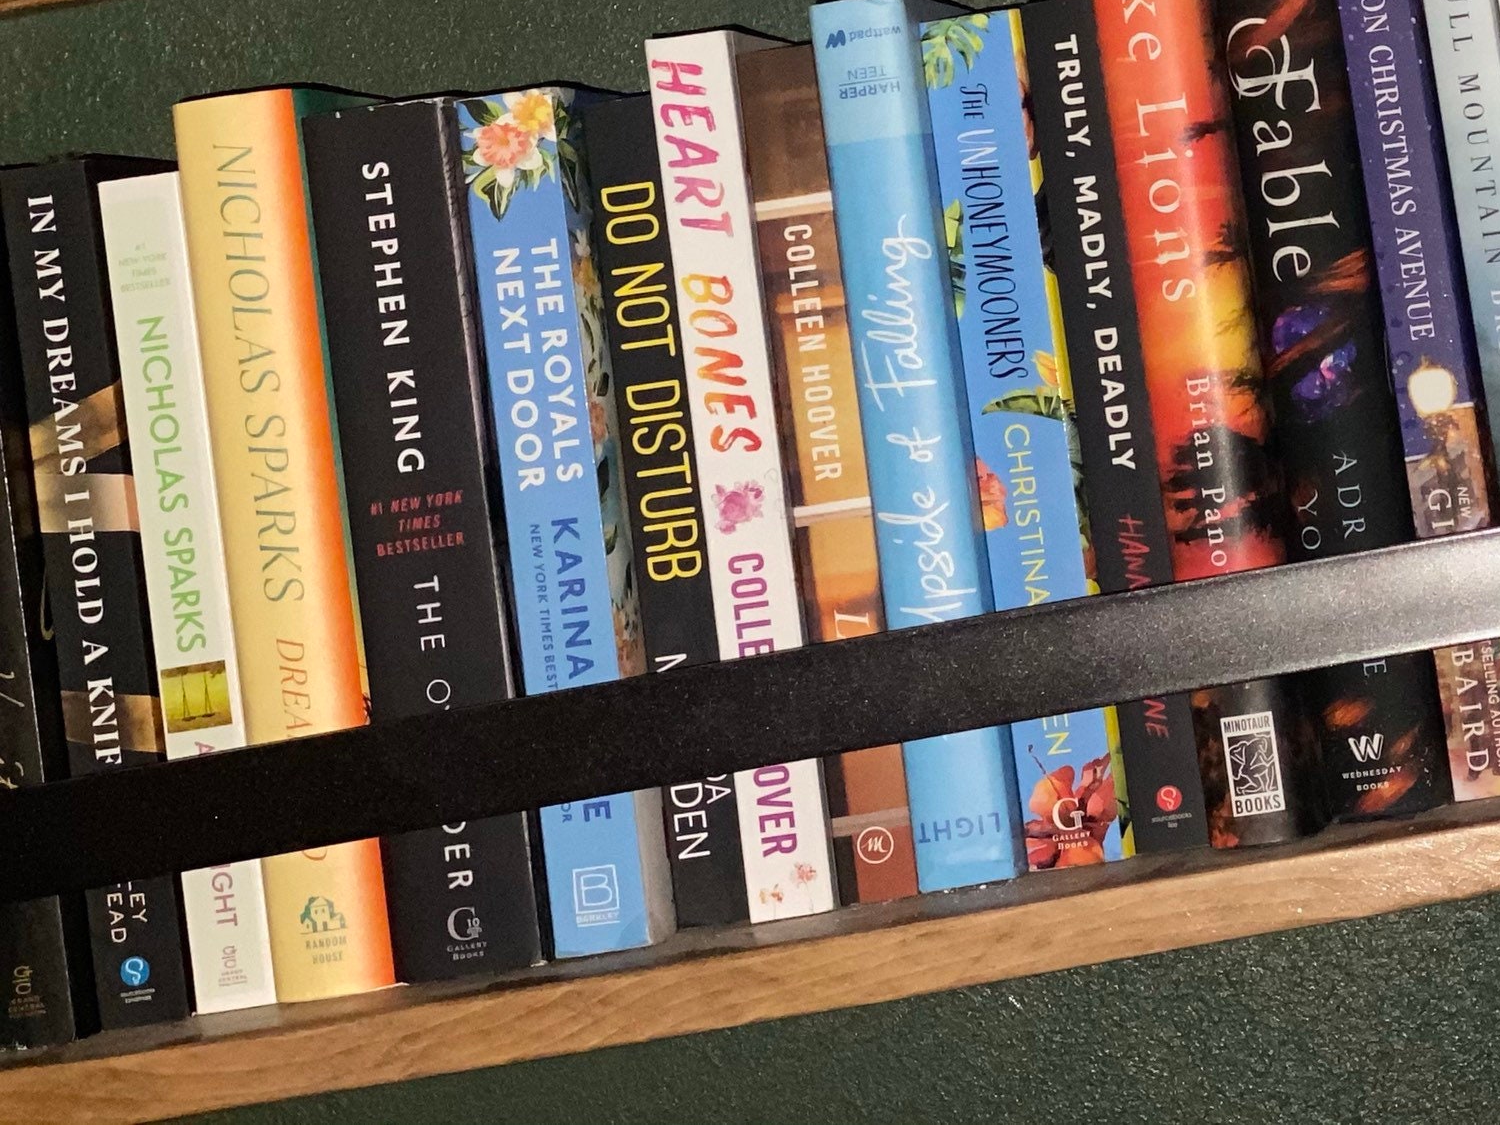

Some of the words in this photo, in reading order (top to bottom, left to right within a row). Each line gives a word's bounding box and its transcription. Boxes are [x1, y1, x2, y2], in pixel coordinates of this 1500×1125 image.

[848, 25, 902, 43] wattpad
[838, 79, 901, 100] HARPER
[847, 65, 888, 81] TEEN
[959, 83, 990, 121] THE
[651, 59, 734, 237] HEART
[1226, 17, 1341, 283] Fable
[27, 194, 58, 233] IN
[601, 181, 660, 245] DO
[1133, 92, 1199, 303] Lions
[1367, 44, 1417, 217] CHRISTMAS
[1394, 226, 1436, 342] AVENUE
[34, 248, 66, 302] MY
[212, 143, 282, 394] NICHOLAS
[362, 161, 411, 347] STEPHEN
[531, 237, 564, 316] THE
[783, 223, 829, 352] COLLEEN
[957, 128, 1030, 380] UNHONEYMOONERS
[1054, 33, 1092, 158] TRULY,
[1073, 175, 1113, 310] MADLY,
[1093, 326, 1137, 471] DEADLY
[493, 247, 531, 355] NEXT
[611, 262, 676, 357] NOT
[860, 213, 938, 412] Falling
[42, 316, 87, 477] DREAMS
[681, 272, 762, 453] BONES
[386, 369, 426, 474] KING
[506, 368, 545, 492] DOOR
[541, 328, 584, 483] ROYALS
[802, 364, 842, 482] HOOVER
[625, 379, 703, 582] DISTURB
[885, 426, 942, 463] of
[1186, 375, 1214, 471] Brian
[1201, 484, 1228, 568] Pano
[64, 489, 91, 504] I
[136, 315, 190, 514] NICHOLAS
[163, 527, 208, 654] SPARKS
[244, 414, 305, 603] SPARKS
[390, 496, 421, 513] NEW
[425, 489, 465, 506] YORK
[1003, 423, 1051, 608] CHRISTINA
[376, 531, 465, 557] BESTSELLER
[397, 514, 442, 533] TIMES
[529, 523, 544, 559] NEW
[67, 516, 105, 624] HOLD
[534, 563, 549, 605] YORK
[551, 516, 595, 680] KARINA
[413, 575, 447, 652] THE
[539, 608, 554, 653] TIMES
[82, 640, 110, 666] A
[1223, 717, 1272, 735] MINOTAUR
[1452, 648, 1490, 773] BAIRD
[1234, 793, 1282, 815] BOOKS
[1341, 765, 1403, 781] WEDNESDAY
[1356, 780, 1391, 792] BOOKS
[918, 812, 1001, 844] LIGHT
[1052, 830, 1092, 843] GALLERY
[1057, 840, 1090, 850] BOOKS
[305, 935, 348, 951] RANDOM
[312, 950, 343, 965] HOUSE
[446, 941, 488, 953] GALLERY
[452, 950, 485, 962] BOOKS
